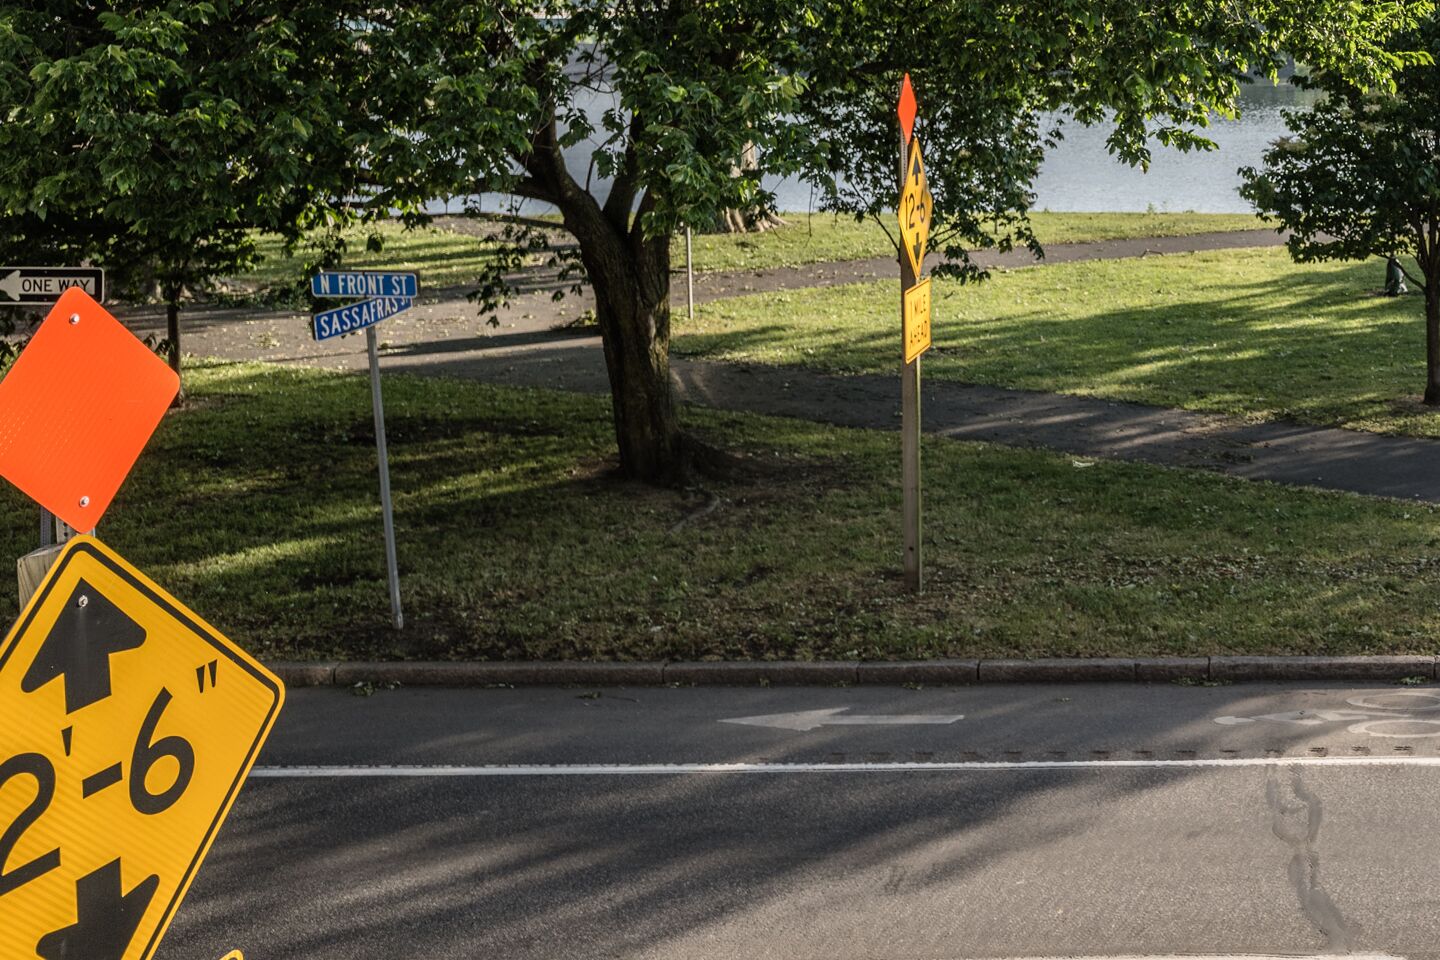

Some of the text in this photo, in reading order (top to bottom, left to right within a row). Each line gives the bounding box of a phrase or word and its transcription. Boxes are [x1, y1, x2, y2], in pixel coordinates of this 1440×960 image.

[22, 278, 52, 292] ONE
[321, 275, 407, 295] N FRONT ST
[914, 293, 926, 316] MILE
[320, 296, 398, 337] SASSAFRAS
[909, 320, 928, 349] AHEAD
